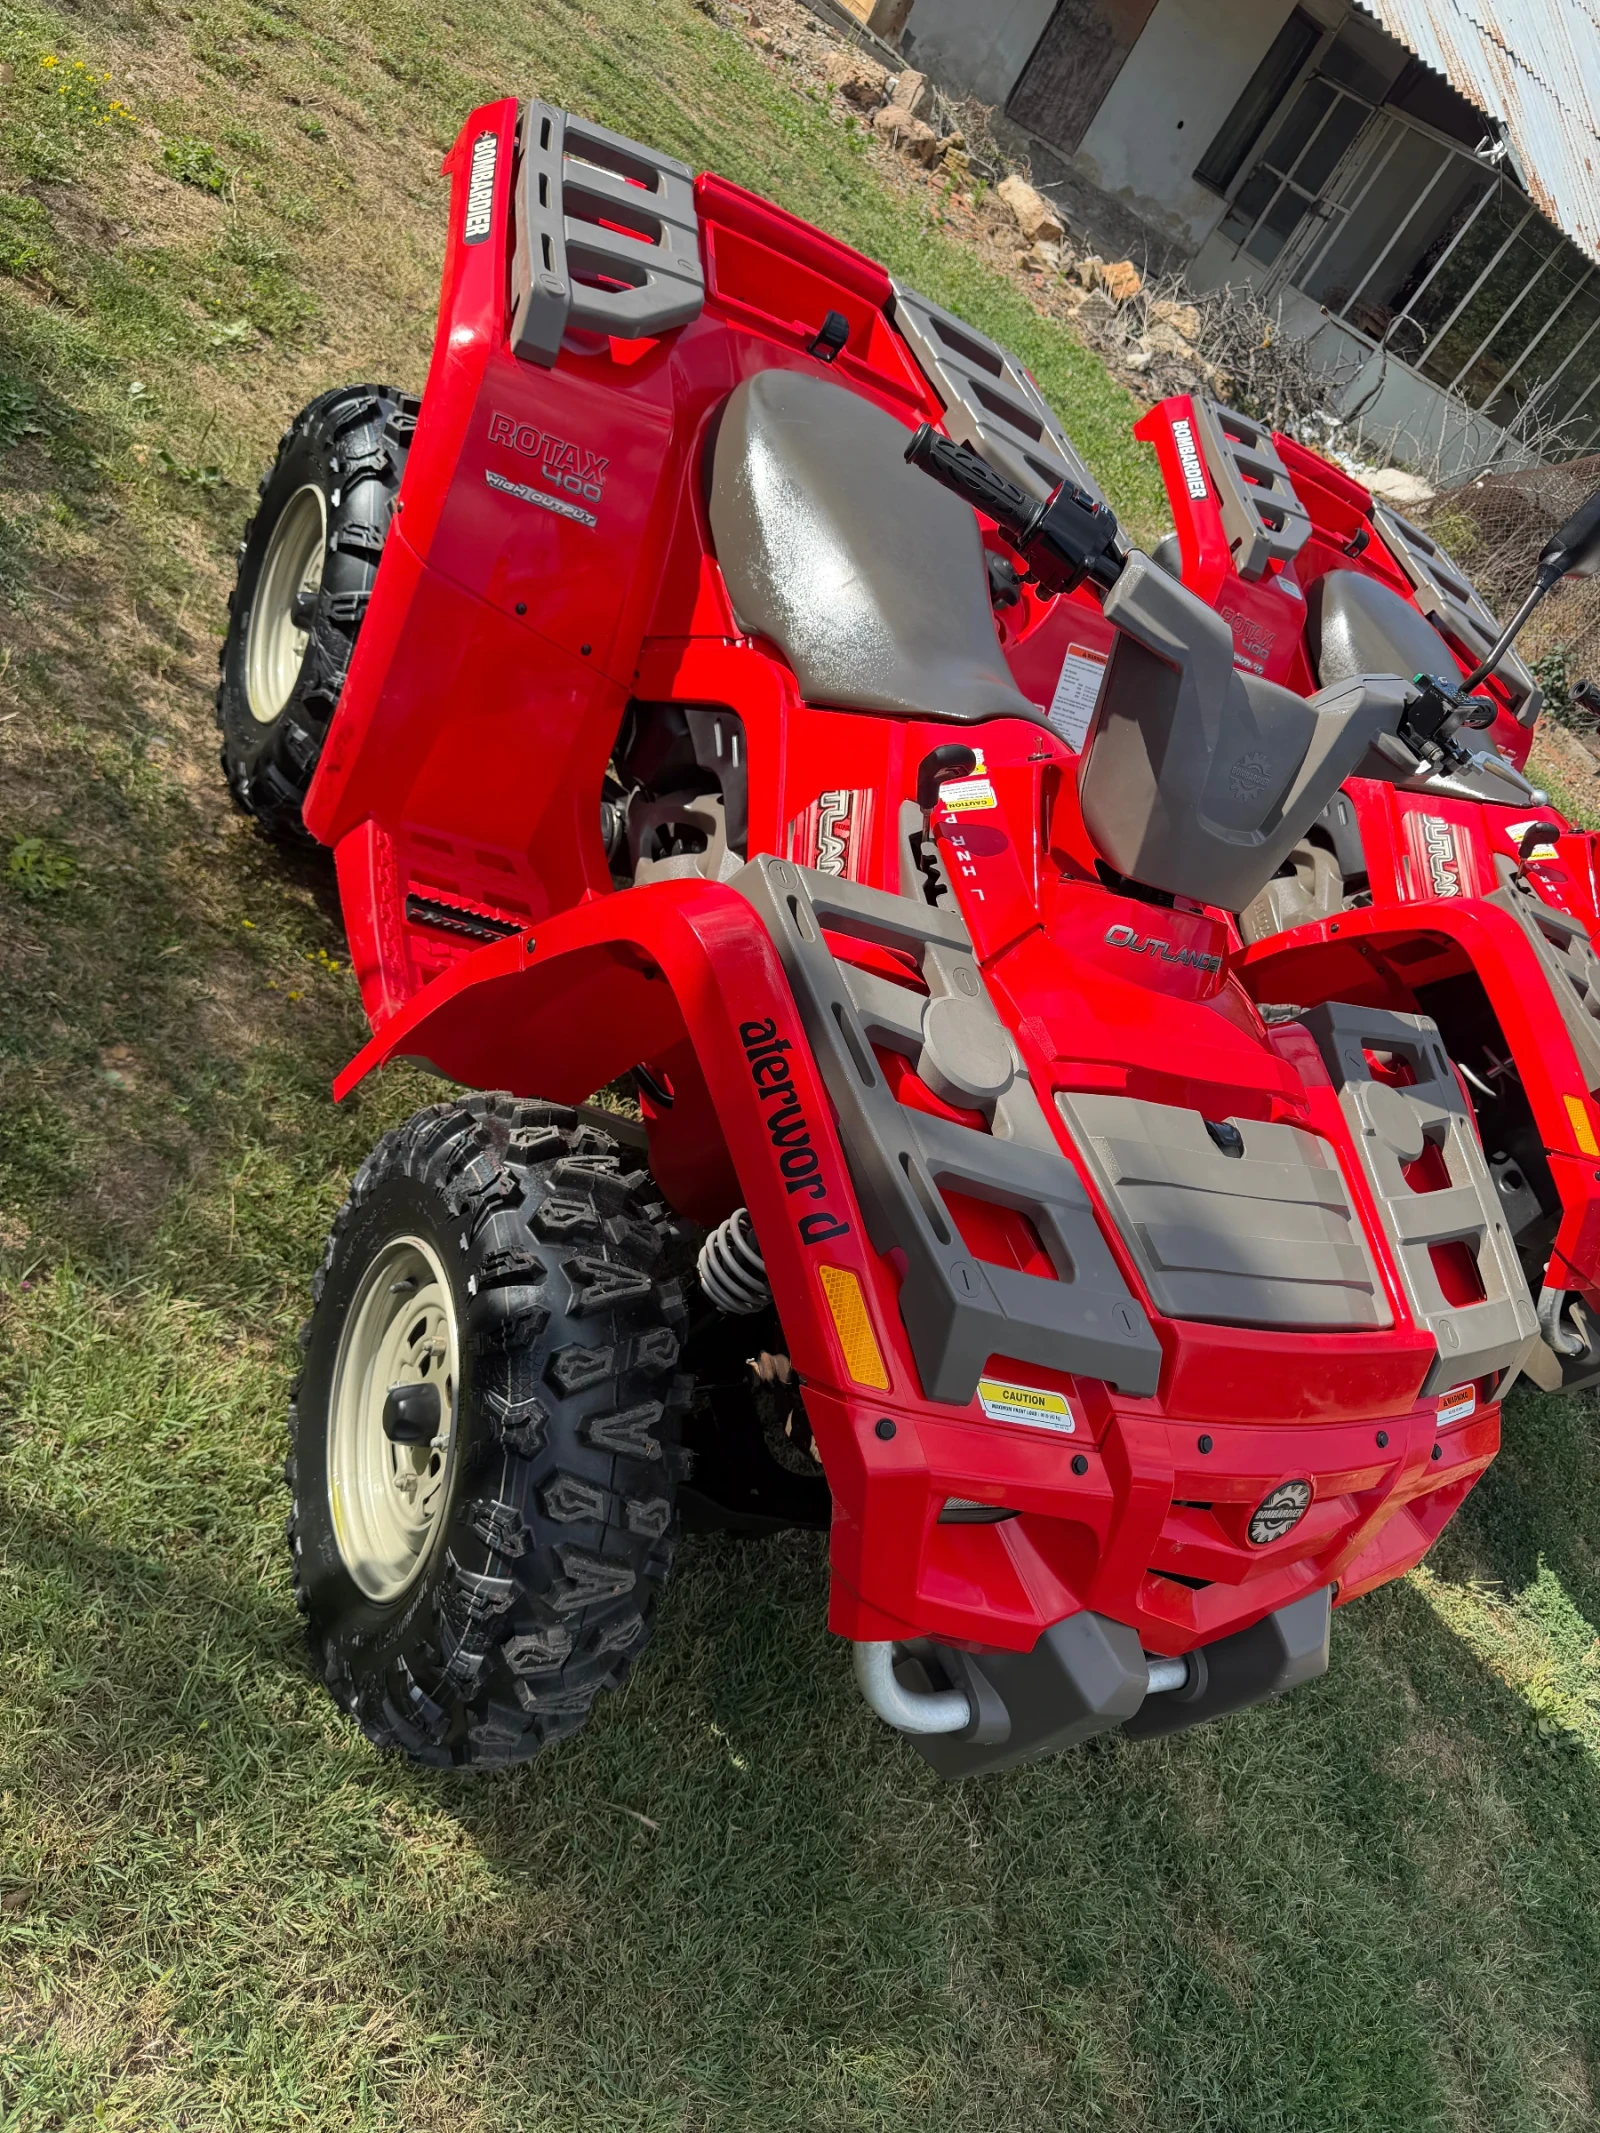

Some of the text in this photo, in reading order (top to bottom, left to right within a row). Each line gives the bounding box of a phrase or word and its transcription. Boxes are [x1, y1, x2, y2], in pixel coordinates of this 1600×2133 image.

[465, 138, 497, 238] BOMBARDIER
[487, 411, 610, 487] ROTAX
[1172, 420, 1207, 499] BOMBARDIER
[541, 465, 602, 503] 400
[488, 473, 596, 523] HIGH OUTPUT
[944, 813, 958, 824] P
[951, 835, 966, 847] R
[956, 850, 972, 862] N
[962, 865, 977, 877] H
[971, 889, 985, 901] L
[1002, 1390, 1046, 1406] CAUTION
[1255, 1508, 1304, 1520] BOMBARDIER
